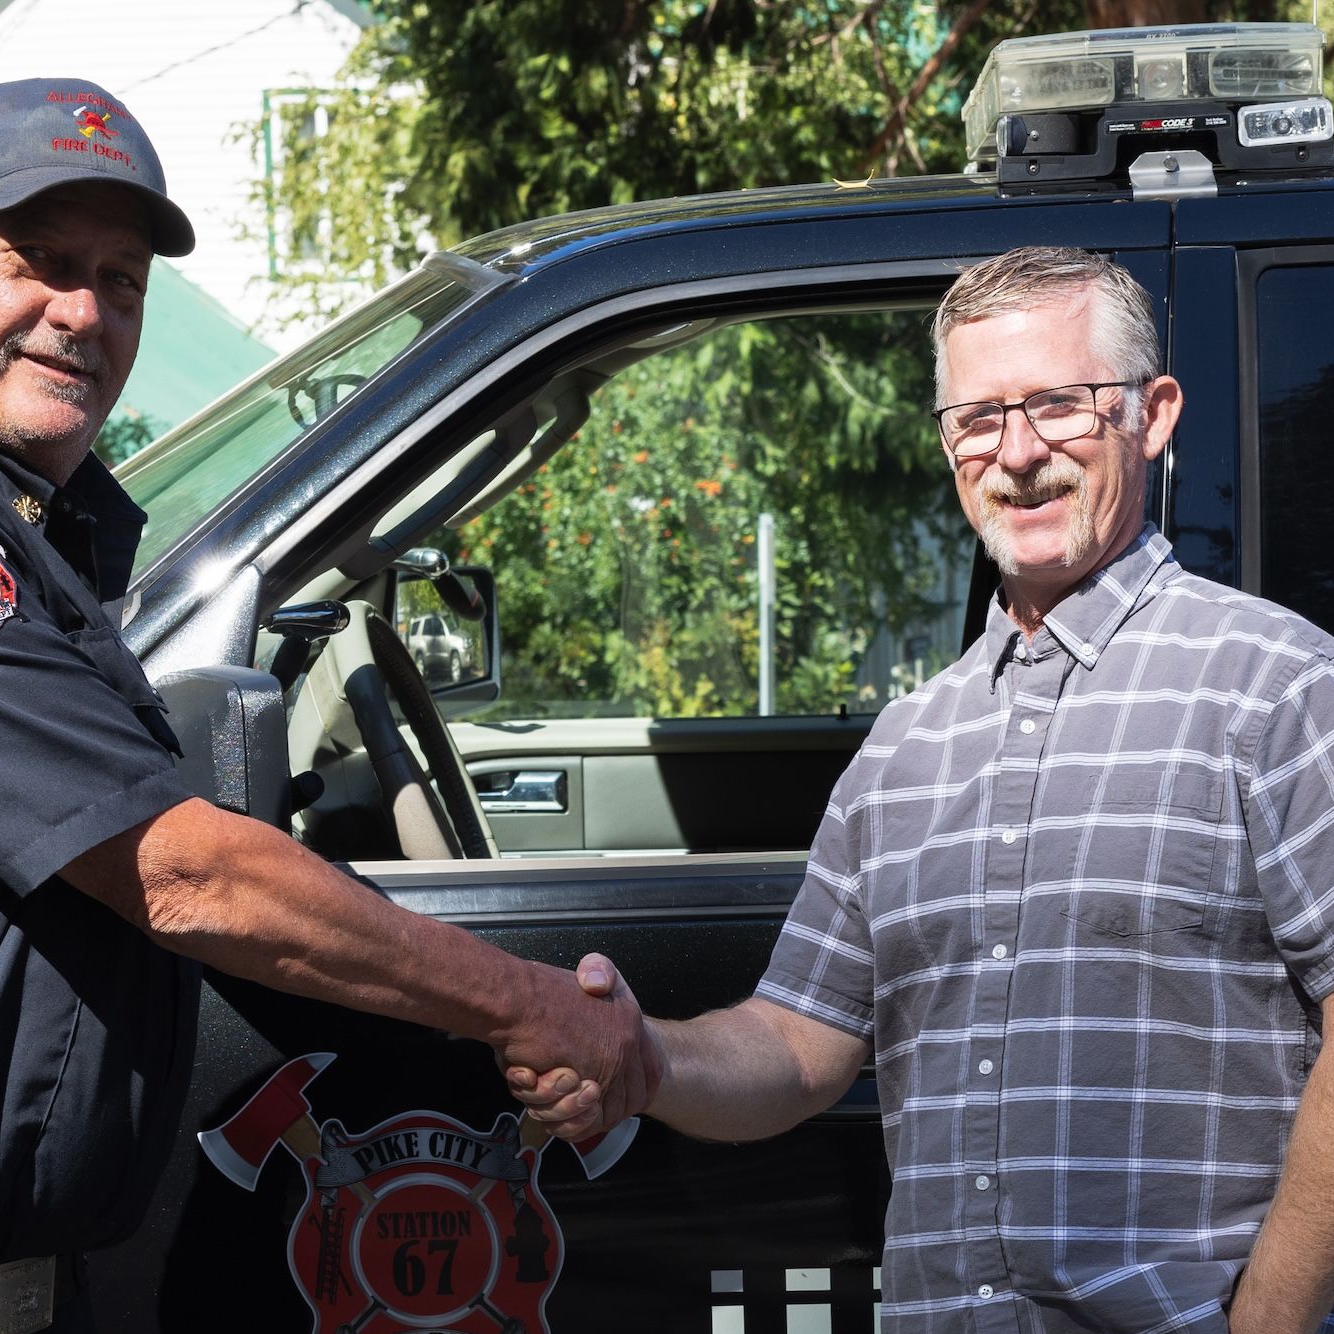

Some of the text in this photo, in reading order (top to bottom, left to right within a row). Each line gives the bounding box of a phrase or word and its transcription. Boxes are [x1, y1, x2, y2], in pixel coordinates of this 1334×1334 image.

[1161, 118, 1186, 128] CODE
[51, 137, 88, 153] FIRE
[351, 1131, 494, 1174] PIKE CITY
[376, 1209, 472, 1240] STATION
[392, 1239, 459, 1298] 67
